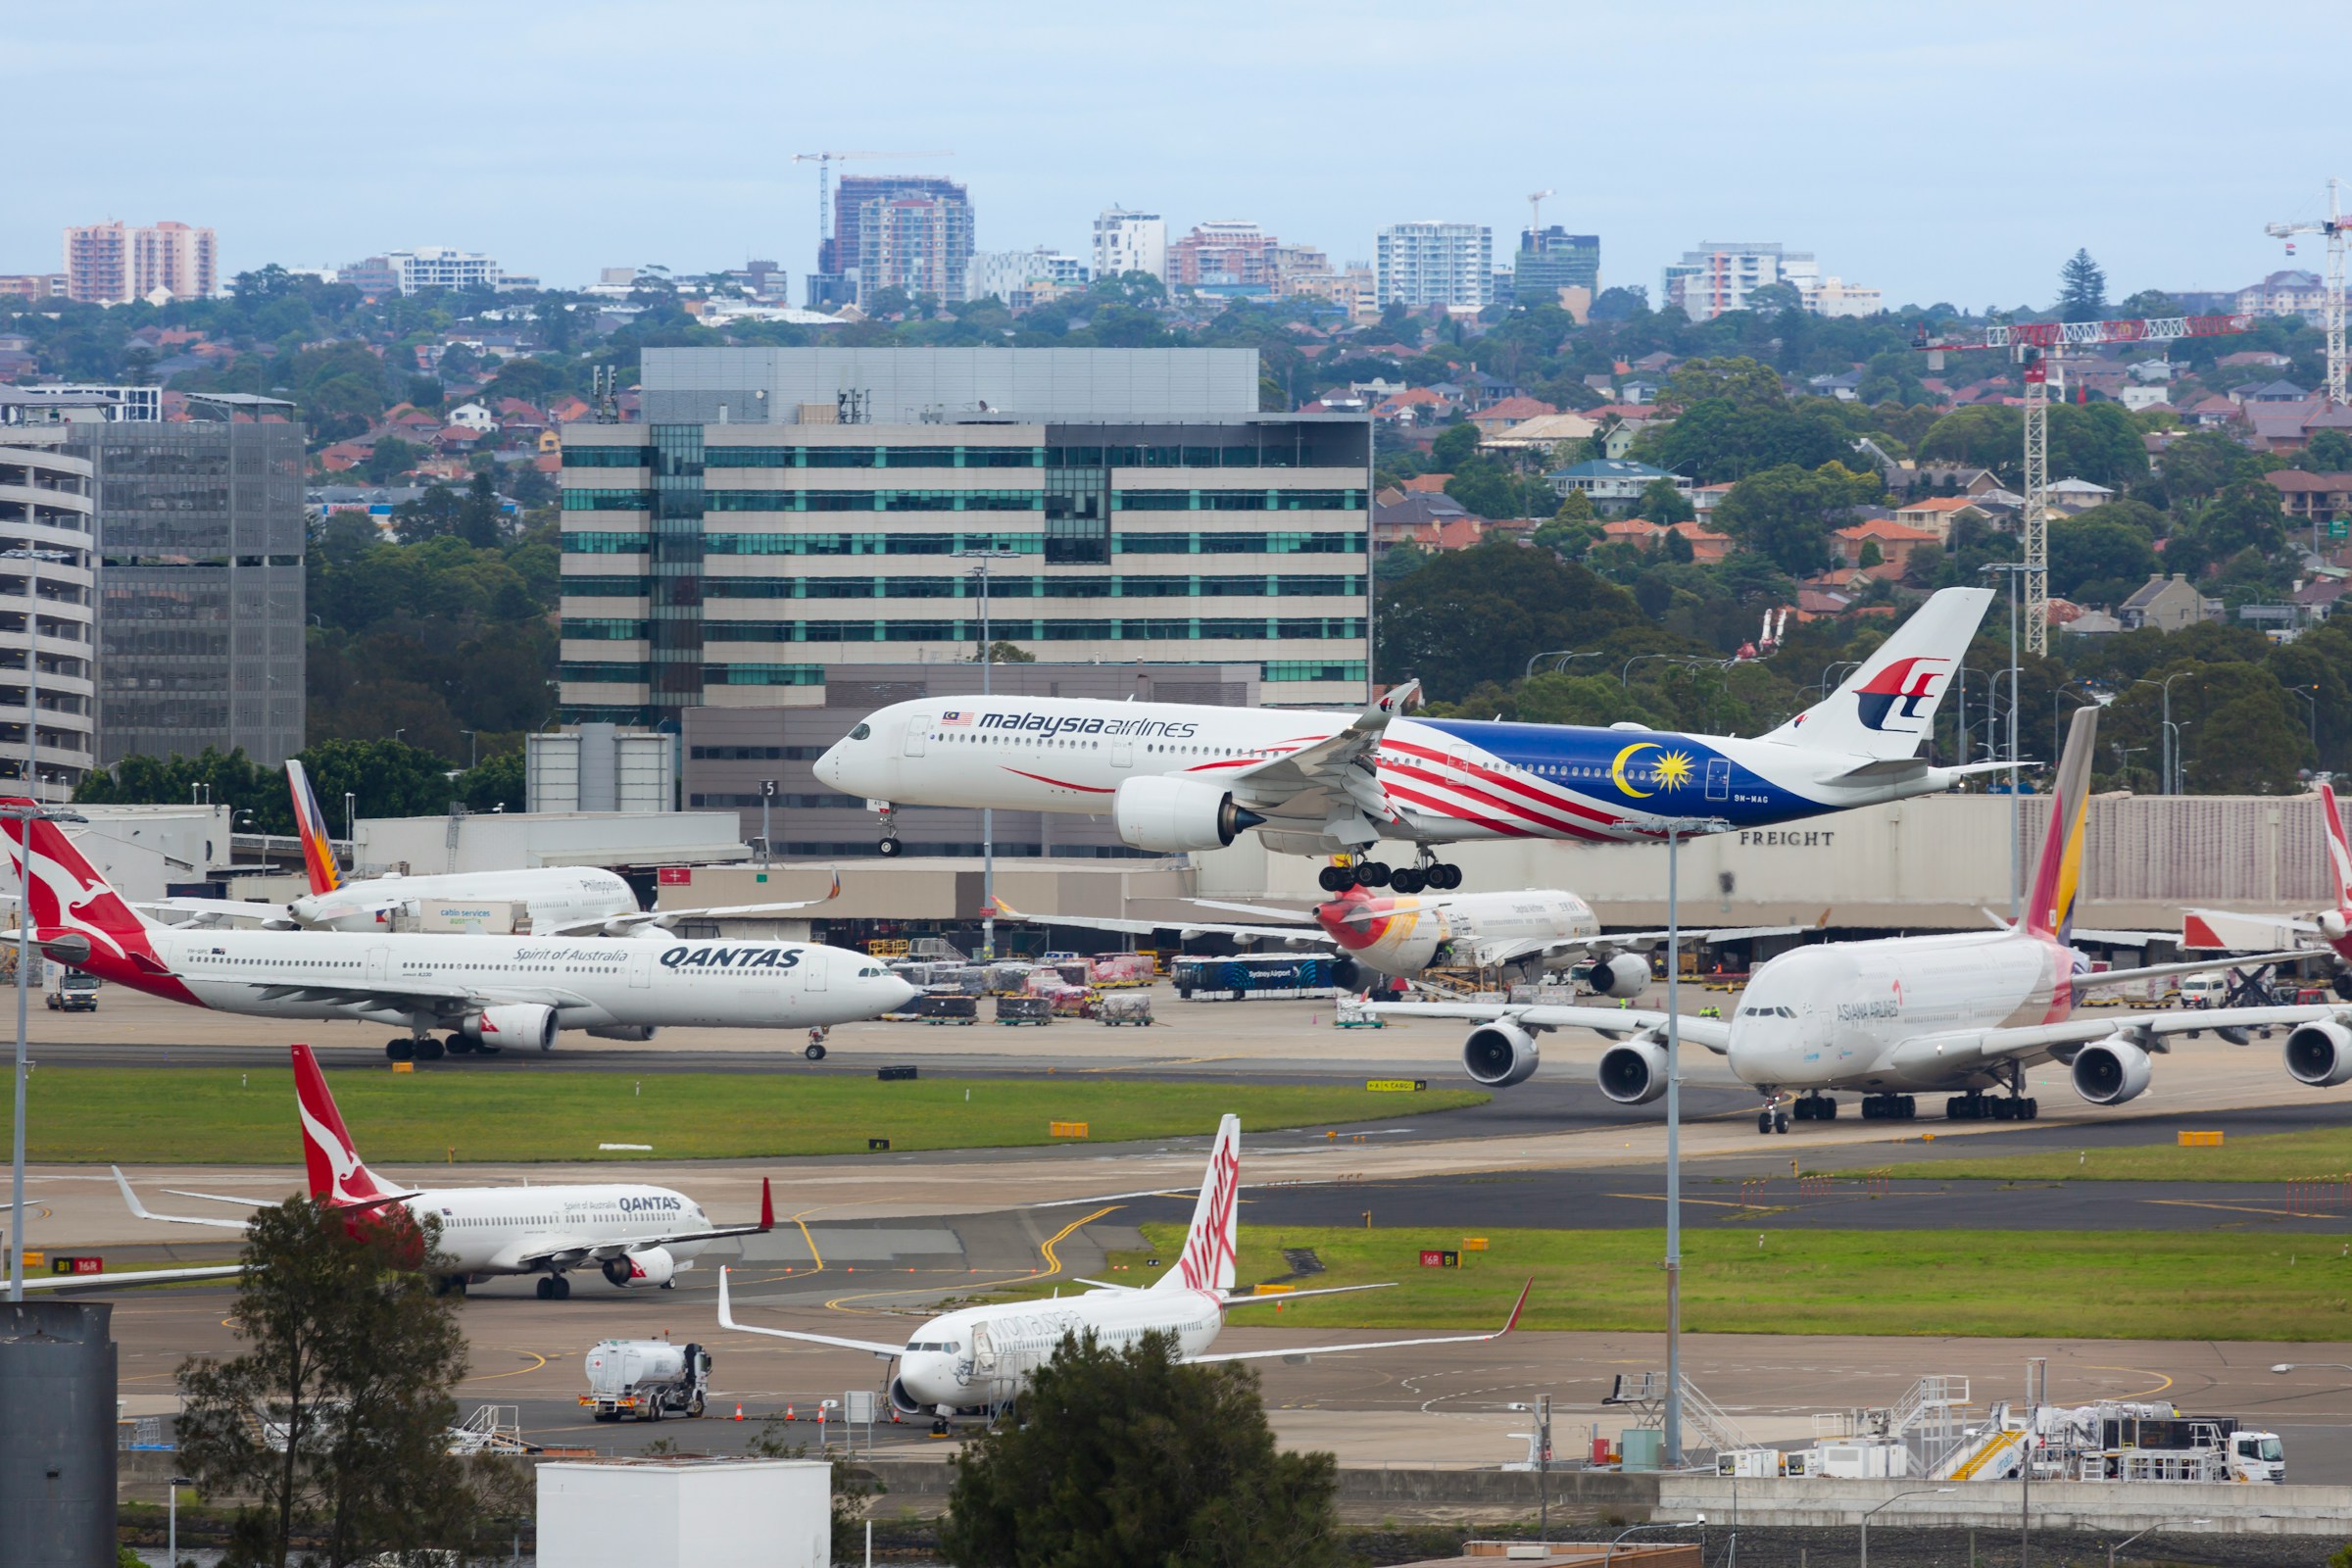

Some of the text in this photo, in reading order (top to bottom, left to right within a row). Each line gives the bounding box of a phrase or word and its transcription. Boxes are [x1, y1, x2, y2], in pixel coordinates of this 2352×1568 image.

[978, 712, 1200, 738] malaysia airlines
[766, 781, 774, 796] 5
[1734, 794, 1769, 804] 9M-MAG
[1740, 831, 1835, 846] FREIGHT
[513, 948, 628, 962] Spirit of Australia
[660, 946, 805, 968] QANTAS
[1270, 969, 1291, 978] Airport
[1837, 1003, 1868, 1021] ASIANA
[619, 1197, 681, 1212] QANTAS
[58, 1260, 71, 1272] B1
[78, 1260, 98, 1272] 16R
[1424, 1254, 1440, 1265] 16R
